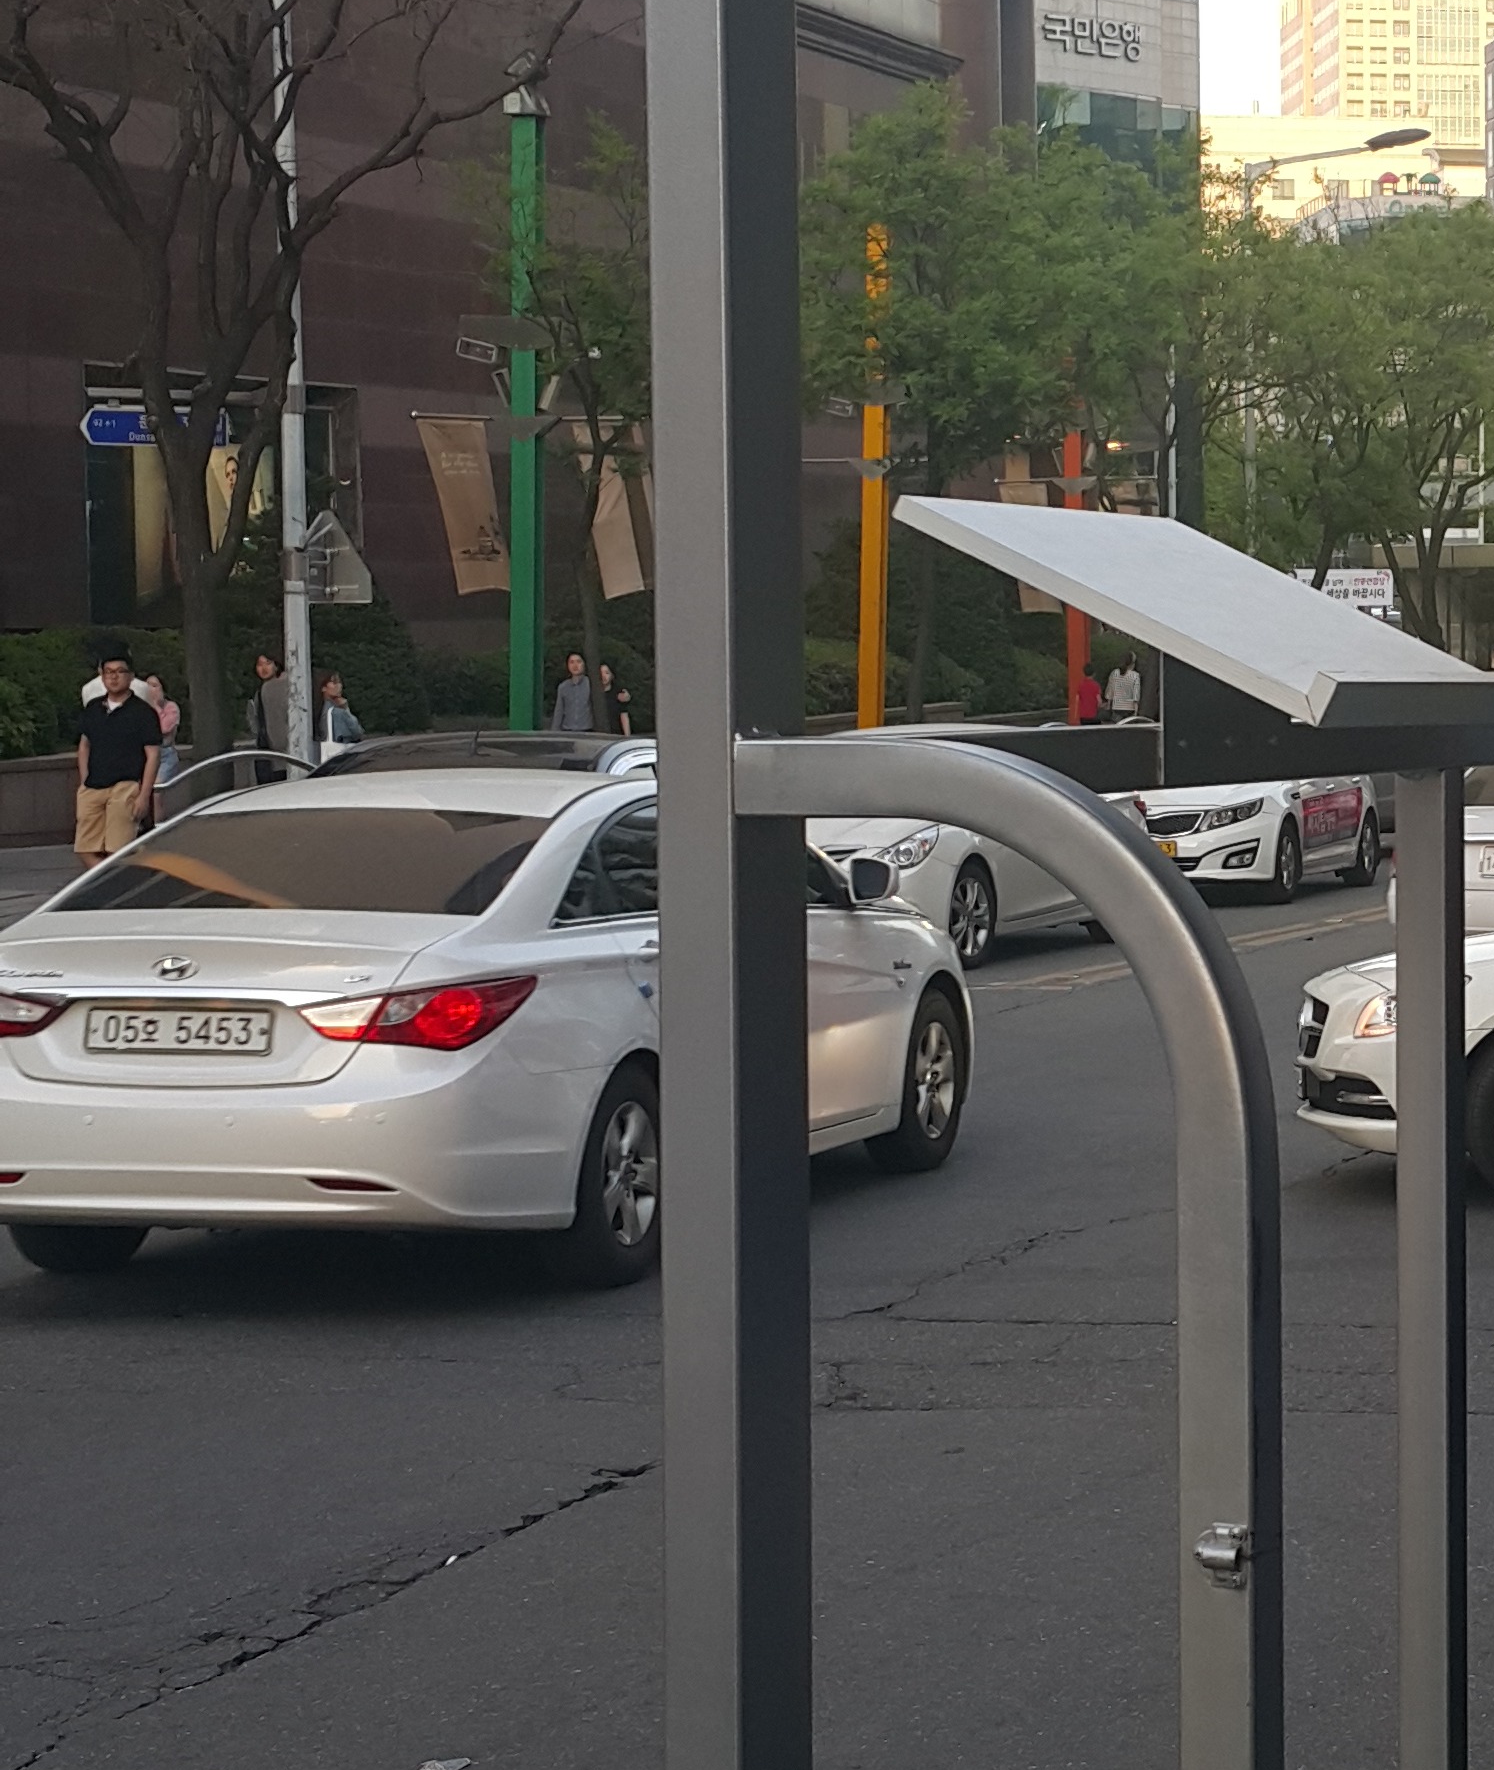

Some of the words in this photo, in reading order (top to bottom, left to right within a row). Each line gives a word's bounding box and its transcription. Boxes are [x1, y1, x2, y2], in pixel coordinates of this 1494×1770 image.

[1042, 13, 1141, 63] 국민은행
[103, 1015, 158, 1044] 05호
[174, 1016, 252, 1046] 5453
